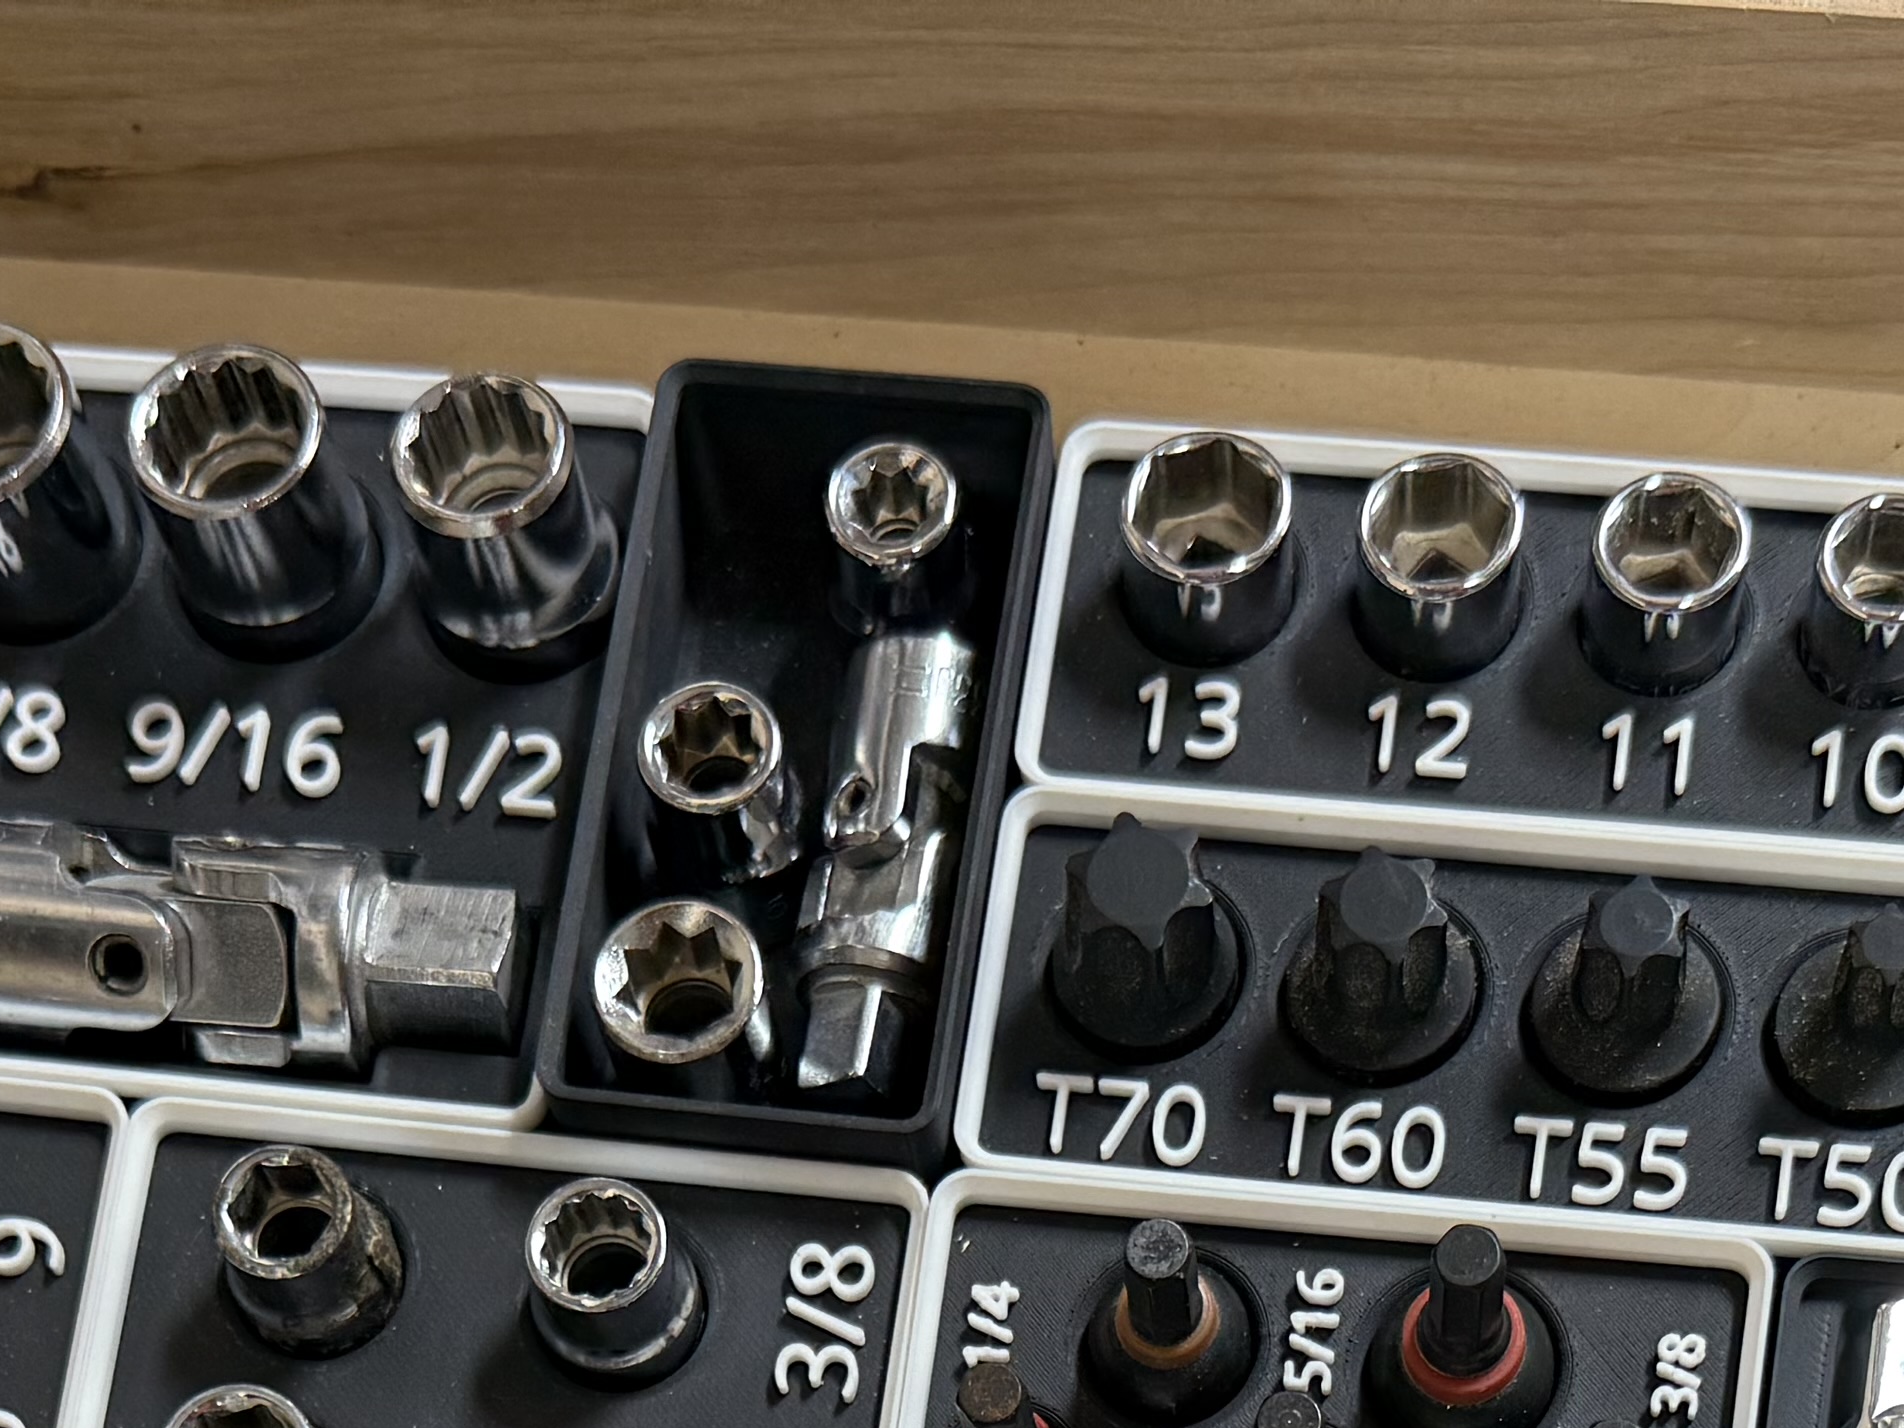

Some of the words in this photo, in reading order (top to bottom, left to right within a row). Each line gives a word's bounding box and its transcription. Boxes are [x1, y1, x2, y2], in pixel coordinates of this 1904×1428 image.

[127, 701, 343, 797] 9/16
[1138, 676, 1242, 759] 13
[1368, 694, 1473, 779] 12
[1602, 713, 1696, 796] 11
[416, 724, 562, 816] 1/2
[1036, 1072, 1207, 1167] T70
[1273, 1094, 1447, 1189] T60
[1514, 1115, 1689, 1211] T55
[774, 1242, 876, 1403] 3/8
[961, 1279, 1021, 1368] 1/4
[1282, 1267, 1345, 1394] 5/16
[1650, 1332, 1708, 1420] 3/8
